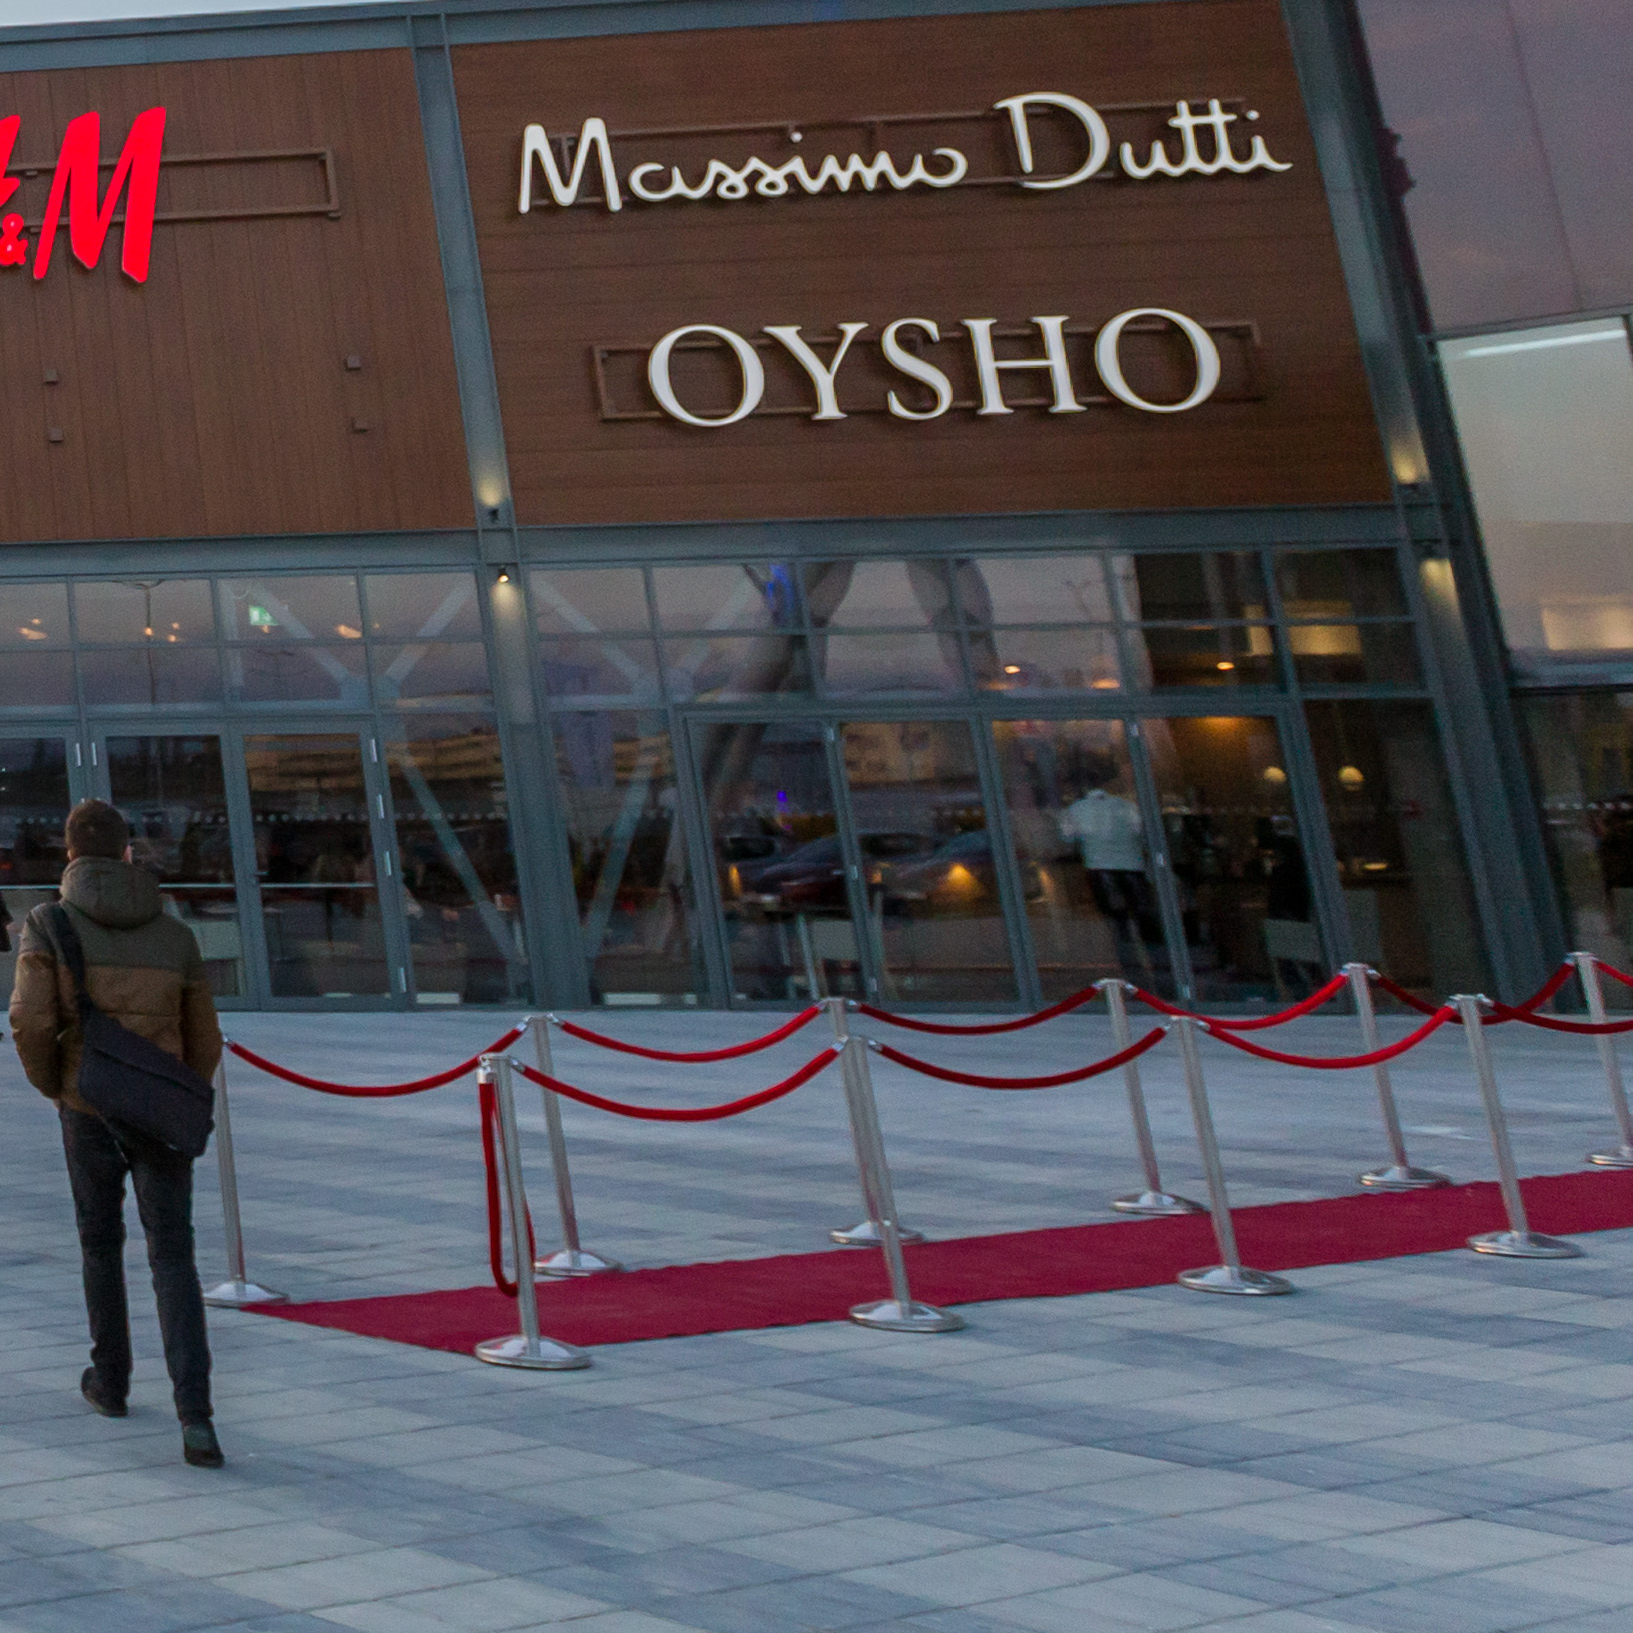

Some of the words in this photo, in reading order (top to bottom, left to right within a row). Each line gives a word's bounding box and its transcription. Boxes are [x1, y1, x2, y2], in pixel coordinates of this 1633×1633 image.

[518, 118, 968, 214] Massimo
[994, 91, 1293, 189] Dutti
[647, 307, 1222, 427] OYSHO
